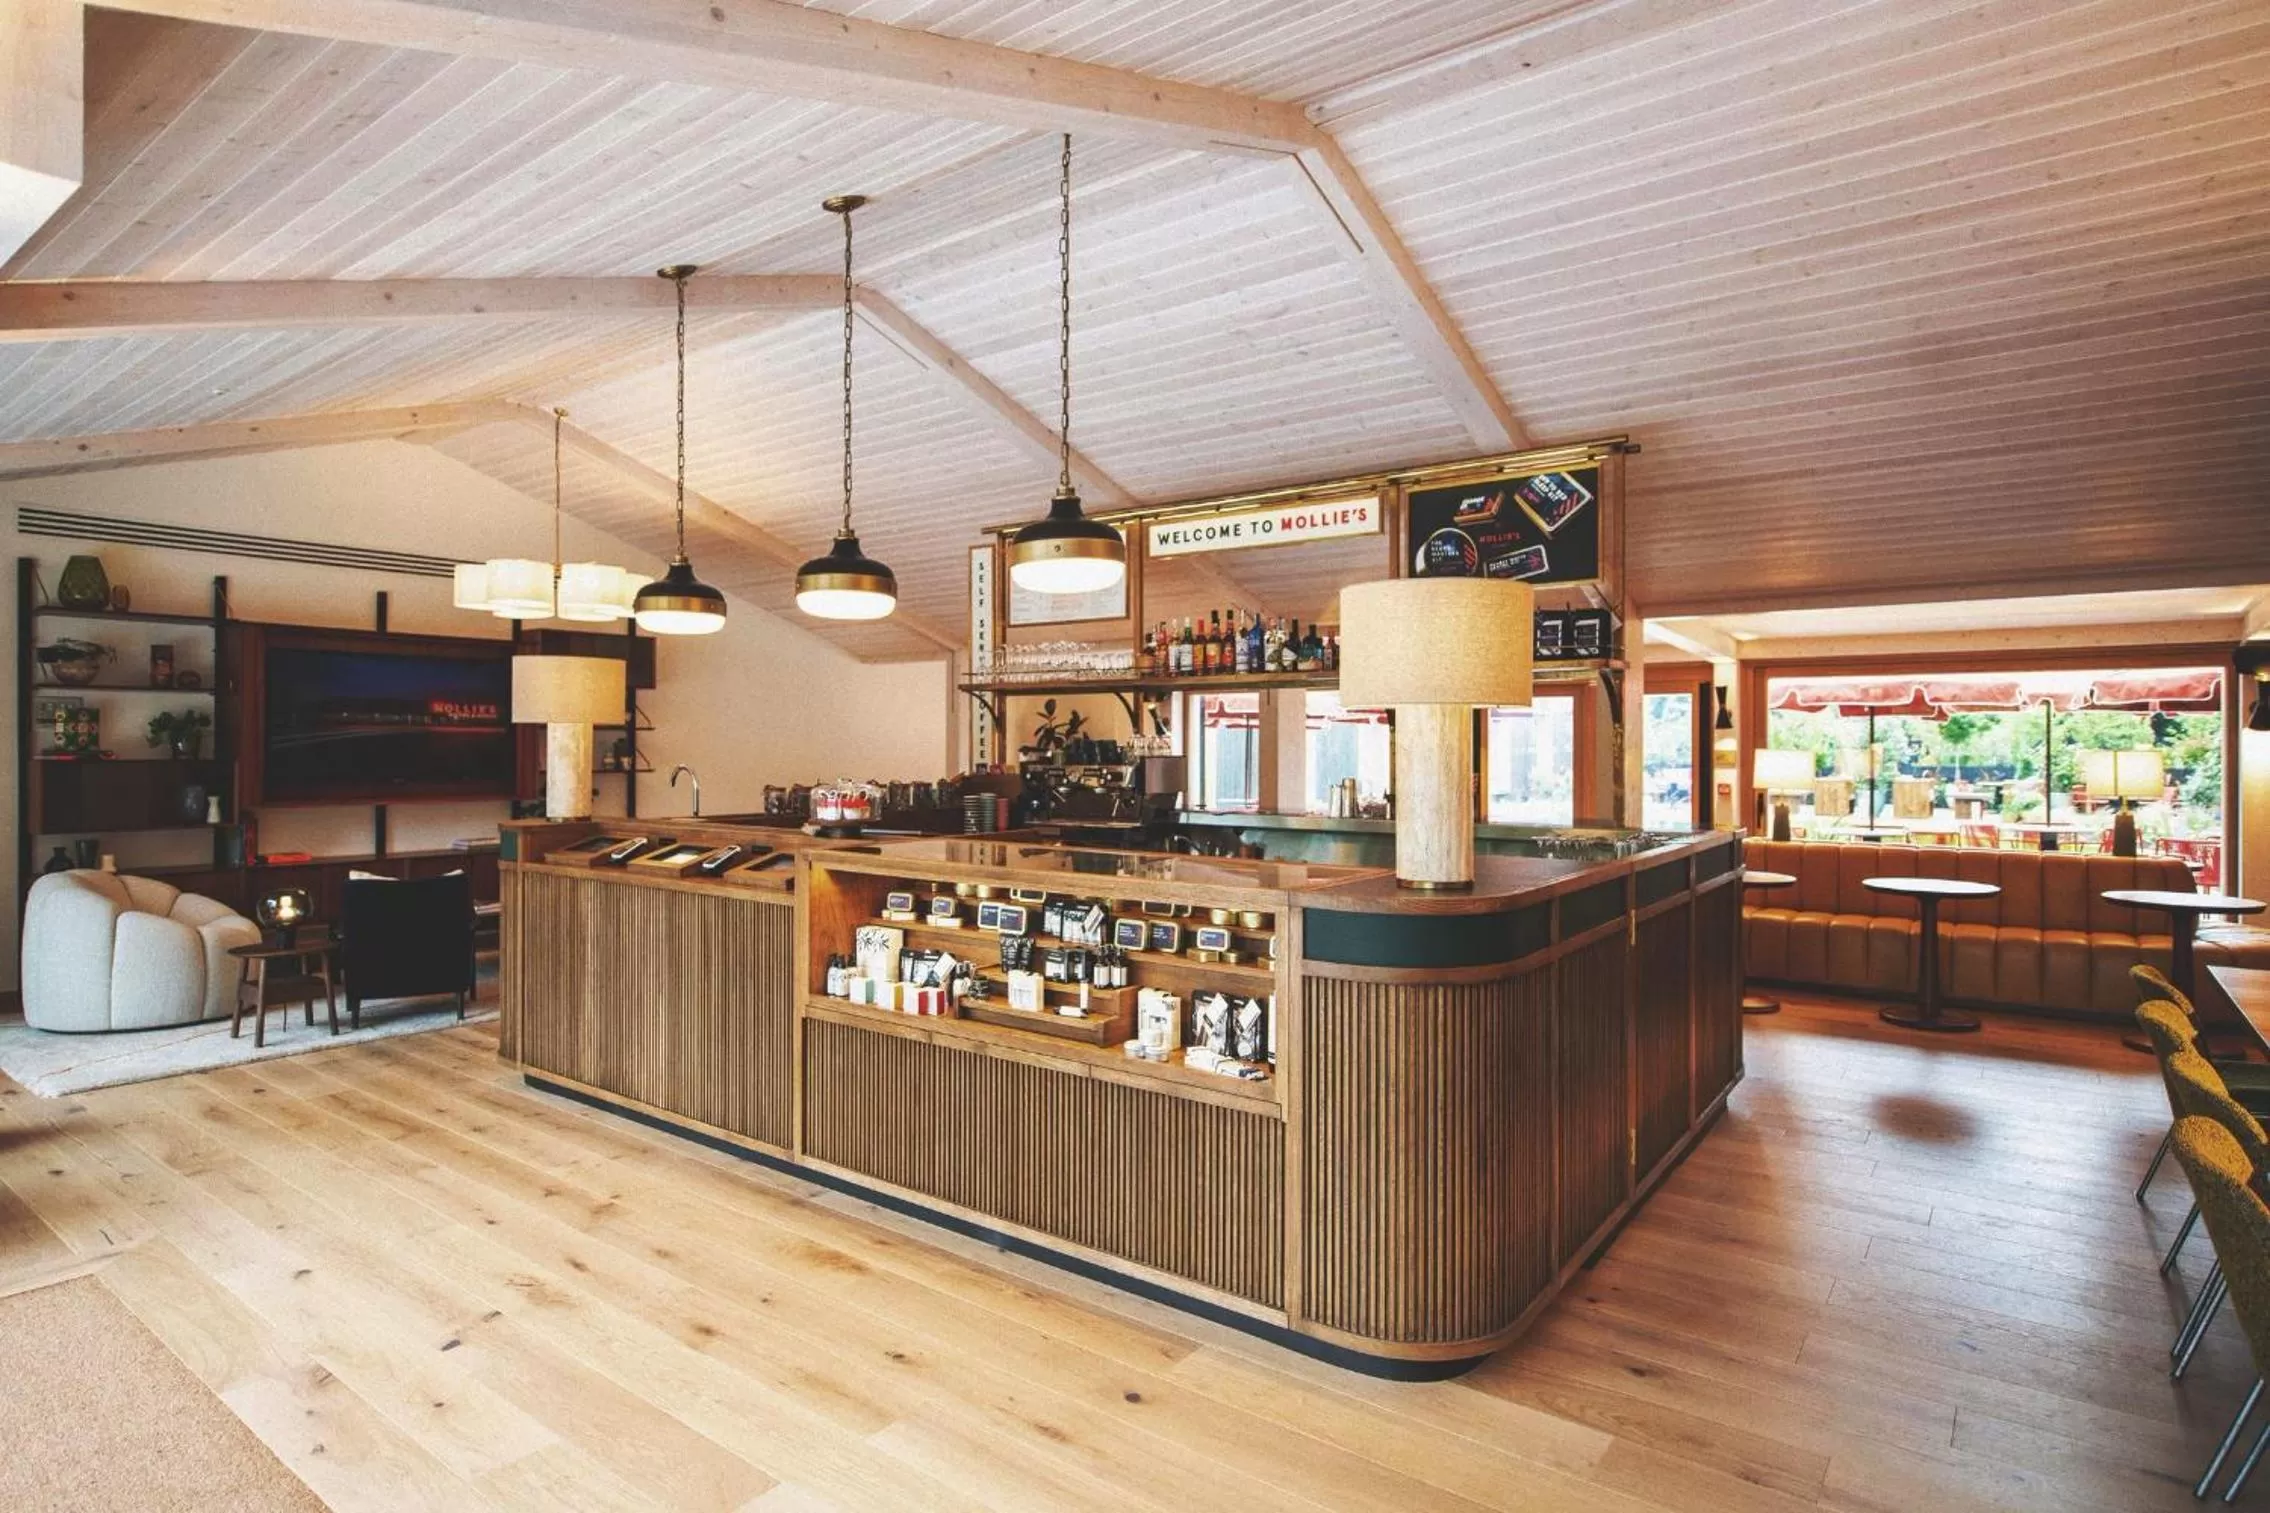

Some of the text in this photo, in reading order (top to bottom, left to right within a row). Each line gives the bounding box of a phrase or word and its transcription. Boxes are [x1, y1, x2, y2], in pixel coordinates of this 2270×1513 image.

[1157, 507, 1368, 546] WELCOME TO MOLLIE'S
